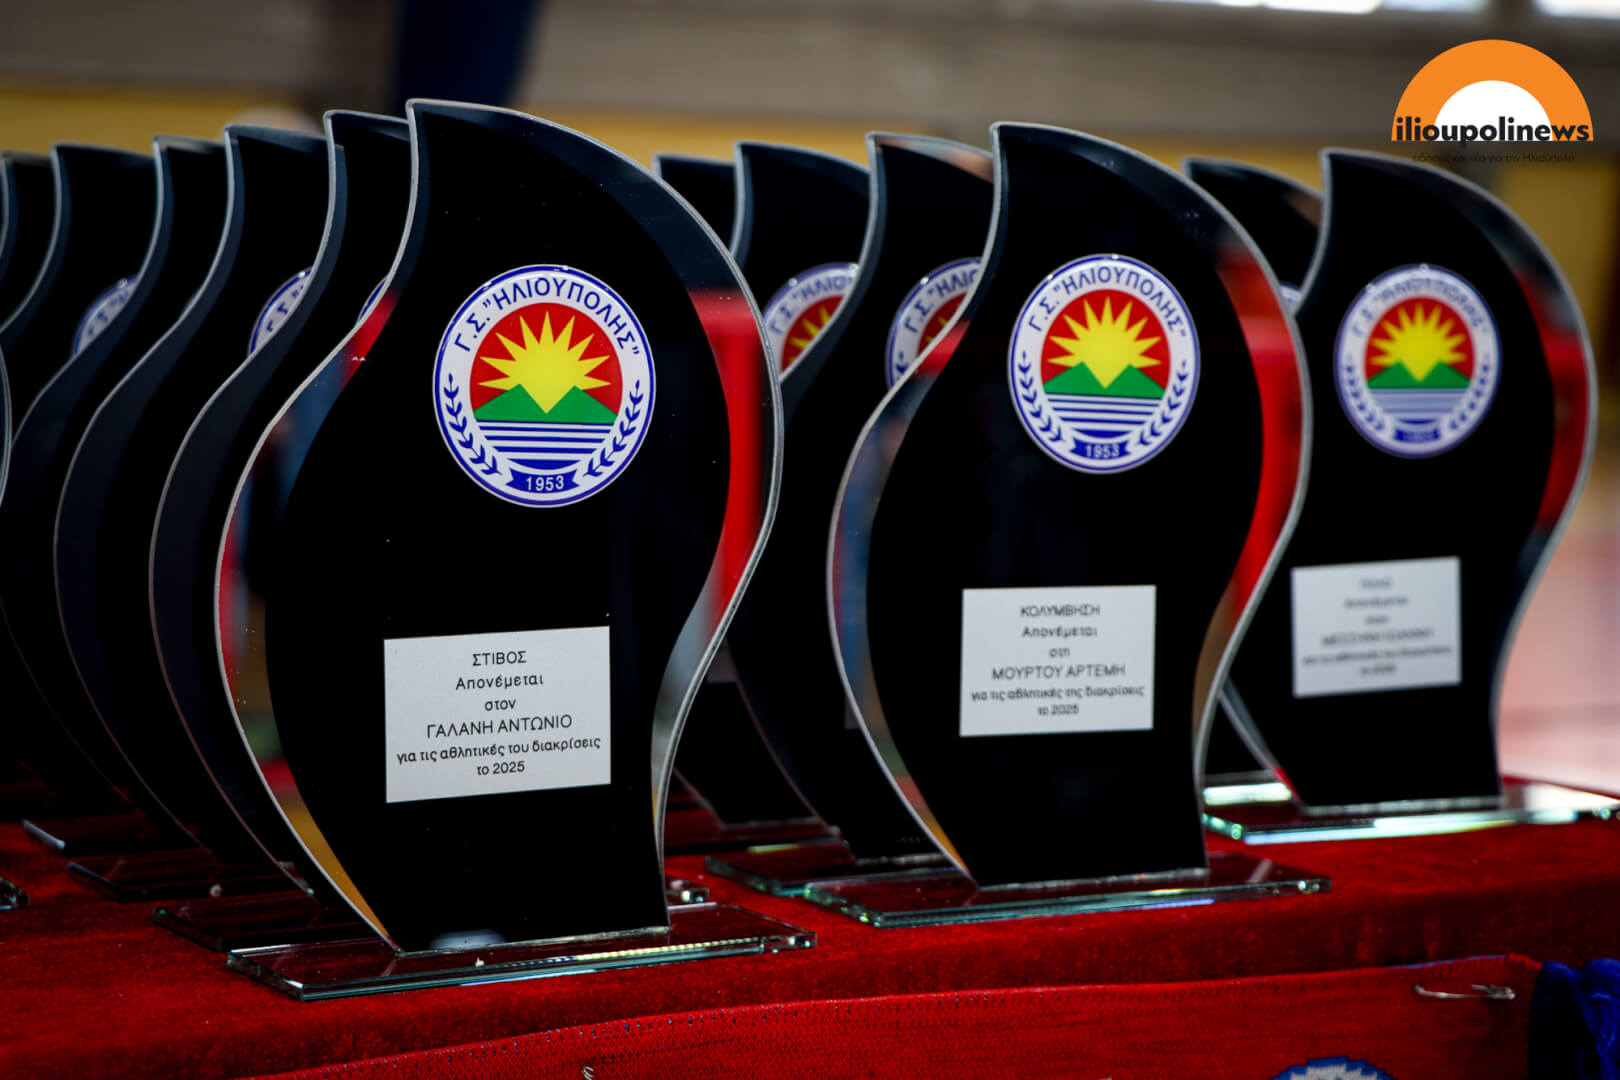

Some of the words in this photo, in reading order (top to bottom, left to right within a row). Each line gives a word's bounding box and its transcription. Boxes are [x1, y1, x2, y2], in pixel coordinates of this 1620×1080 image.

[1086, 444, 1120, 458] 1953
[526, 475, 565, 492] 1953
[1020, 604, 1101, 617] ΚΟΛΥΜΒΗΣΗ
[1022, 626, 1097, 638] Απονέμεται
[473, 651, 526, 666] ΣΤΙΒΟΣ
[992, 665, 1063, 680] ΜΟΥΡΤΟΥ
[1066, 664, 1126, 678] ΑΡΤΕΜΗ
[456, 675, 543, 690] Απονέμεται
[485, 699, 516, 711] στον
[427, 720, 493, 738] ΓΑΛΑΝΗ
[498, 715, 572, 733] ΑΝΤΩΝΙΟ
[397, 752, 417, 764] για
[421, 750, 437, 762] τις
[441, 744, 505, 760] αθλητικές
[509, 742, 529, 753] του
[532, 737, 601, 752] διακρίσεις
[477, 765, 489, 775] το
[492, 761, 525, 774] 2025
